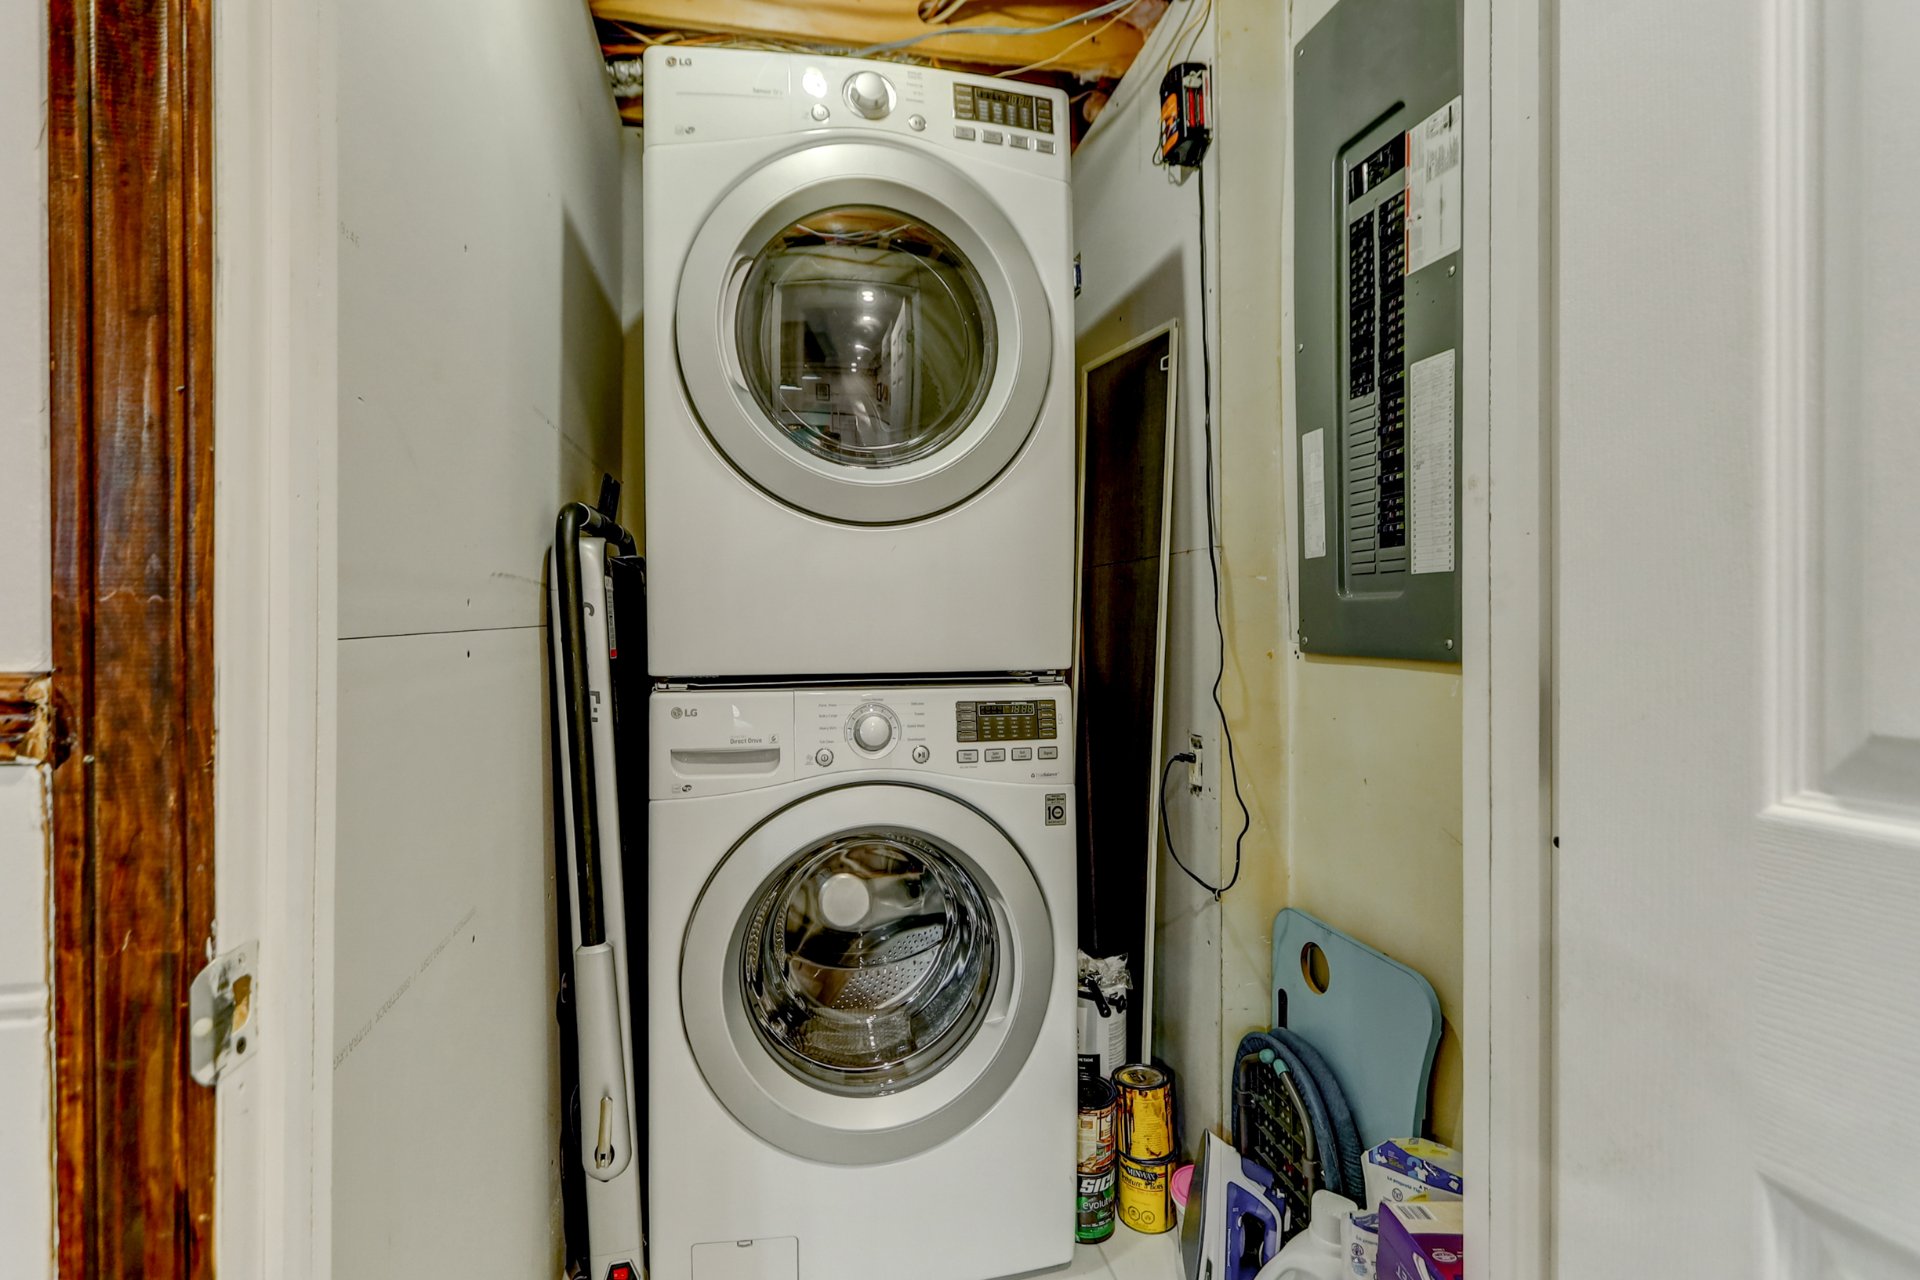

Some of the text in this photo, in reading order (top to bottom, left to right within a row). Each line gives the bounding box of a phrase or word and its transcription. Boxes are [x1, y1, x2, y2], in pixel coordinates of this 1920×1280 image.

[679, 58, 692, 67] LG
[685, 708, 698, 718] LG
[1048, 806, 1064, 820] 10
